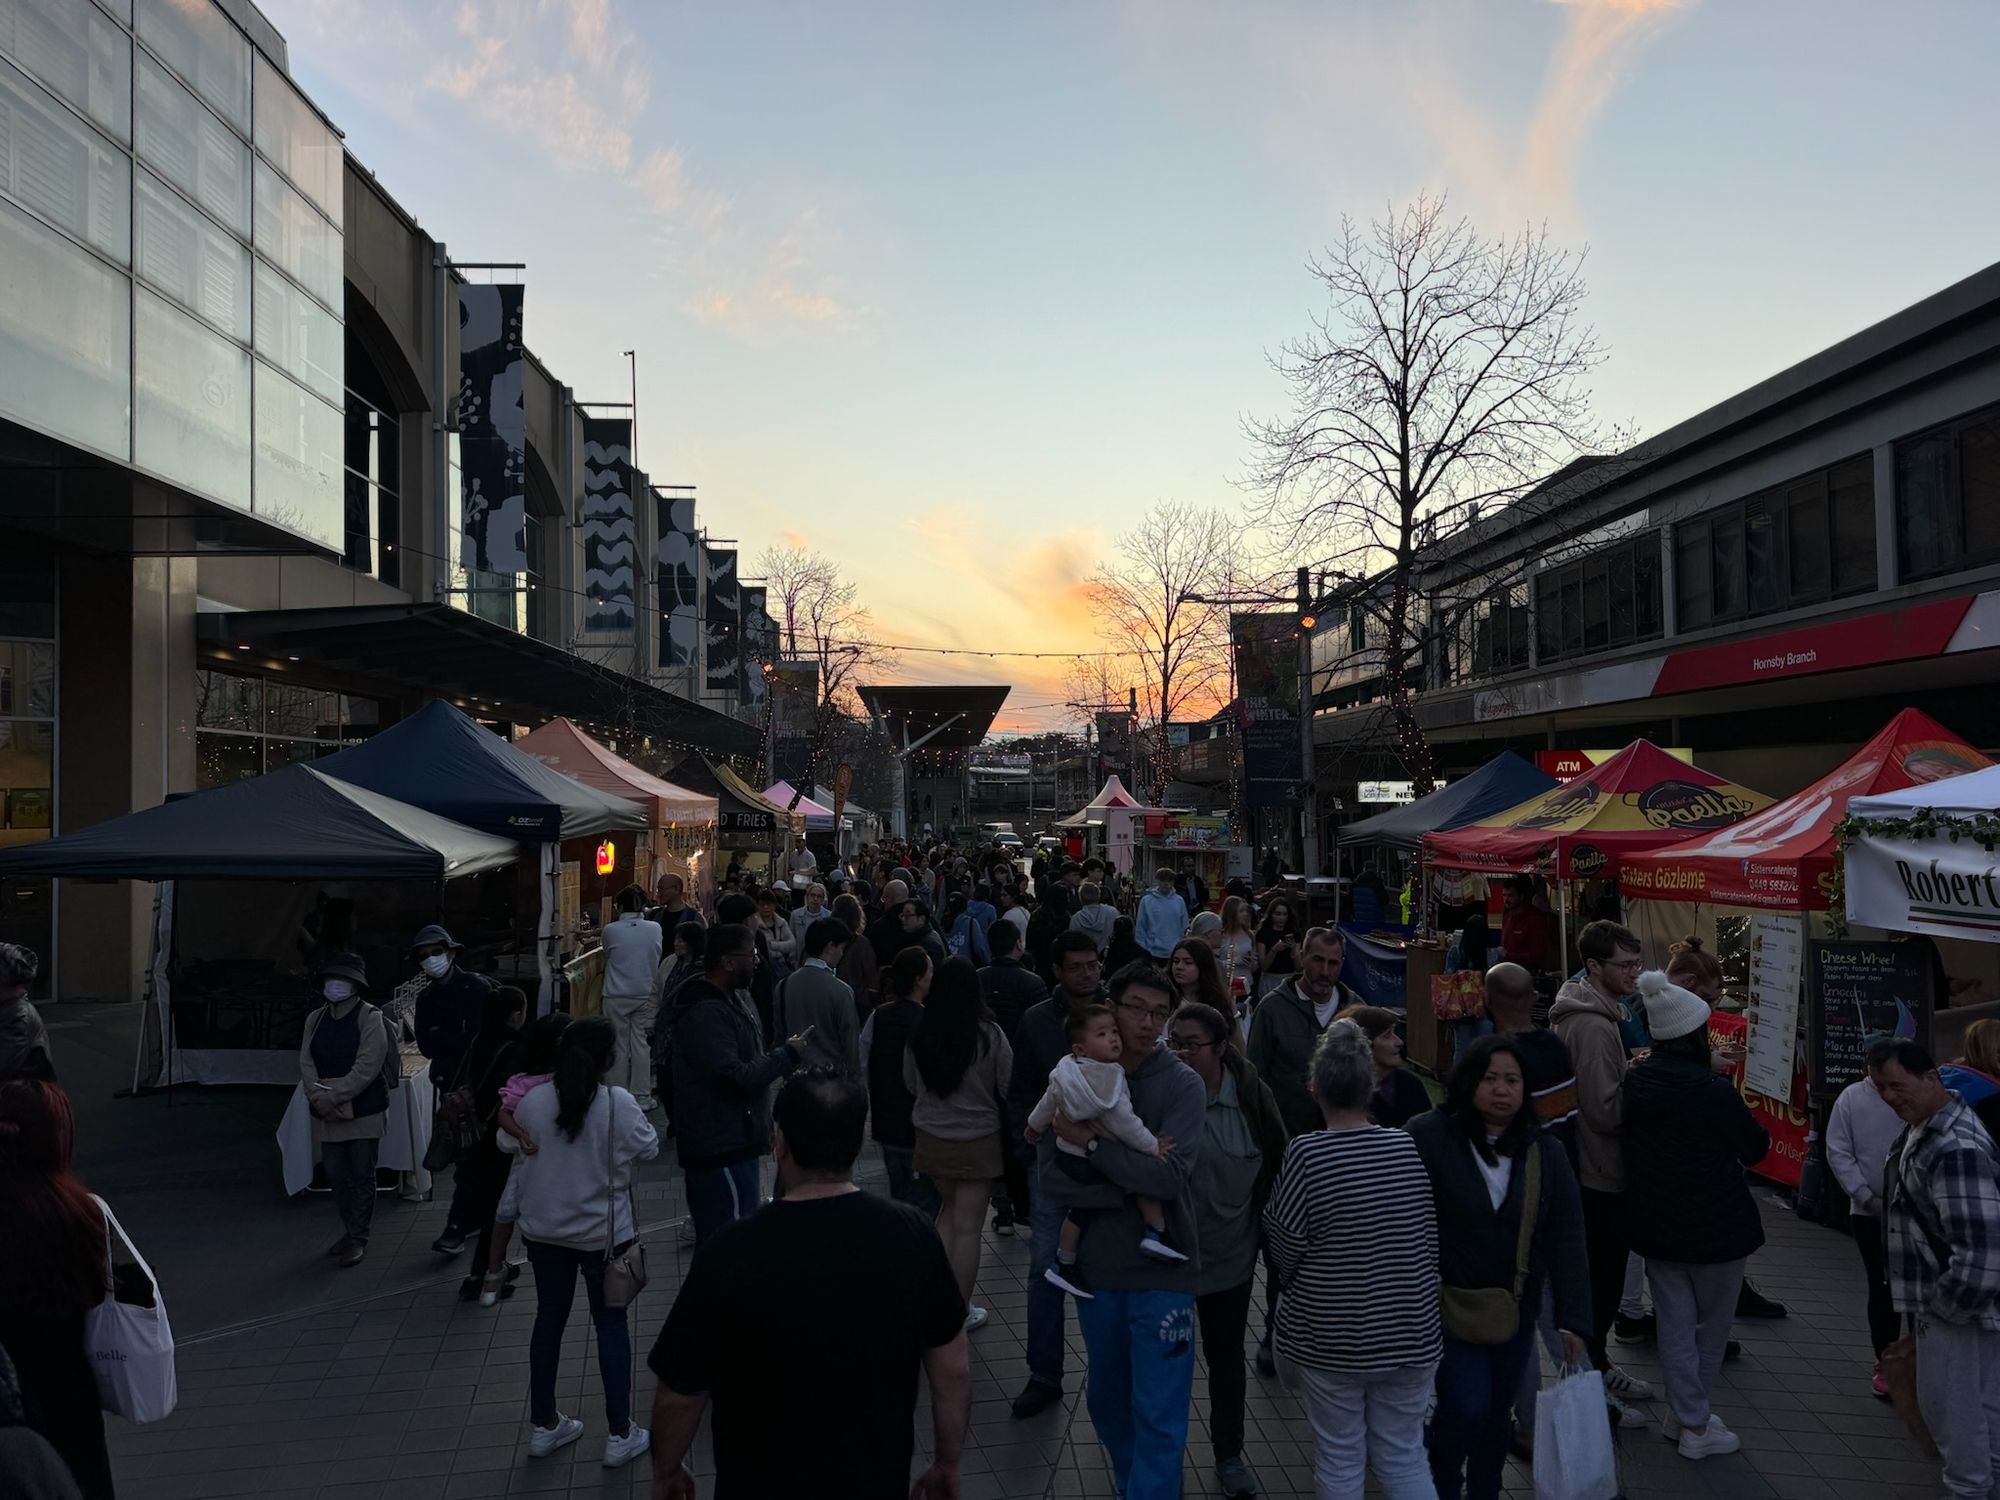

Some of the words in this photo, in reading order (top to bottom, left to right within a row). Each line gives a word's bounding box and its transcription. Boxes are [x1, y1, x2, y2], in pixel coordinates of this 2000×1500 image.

[1752, 656, 1785, 672] Hornsby
[1786, 649, 1817, 665] Branch
[1556, 761, 1581, 772] ATM
[1644, 790, 1754, 829] Paella
[736, 813, 768, 827] FRIES
[1570, 851, 1609, 873] Paella
[1619, 866, 1652, 888] Sisters
[1655, 865, 1706, 890] Gözleme
[1749, 878, 1768, 890] 0449
[1820, 948, 1857, 964] Cheese
[1861, 950, 1895, 965] Wheel
[1824, 1040, 1845, 1053] Mac
[1848, 1044, 1855, 1053] n
[1825, 1065, 1842, 1075] Soft
[96, 1350, 127, 1361] Belle
